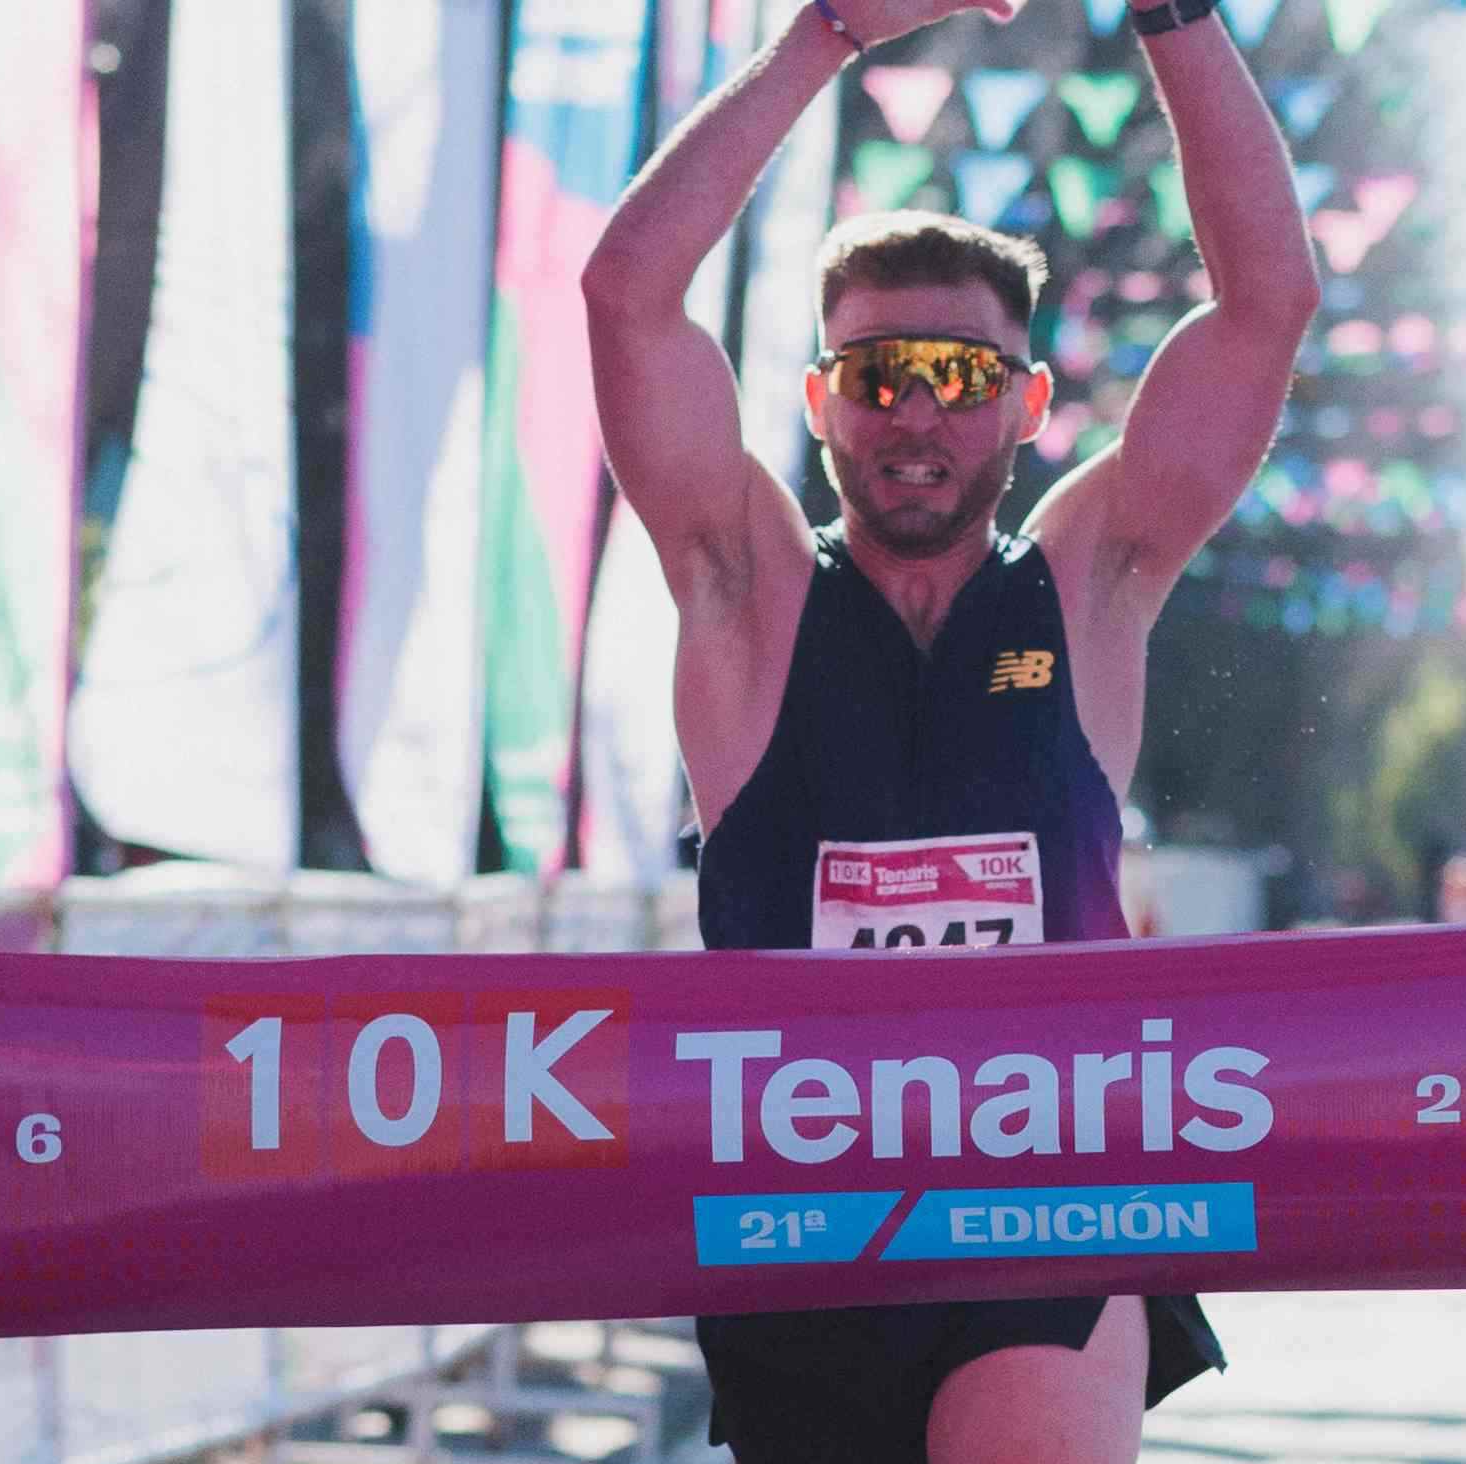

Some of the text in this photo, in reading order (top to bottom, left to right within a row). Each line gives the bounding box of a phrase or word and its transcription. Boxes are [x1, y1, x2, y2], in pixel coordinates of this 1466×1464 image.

[979, 856, 1024, 876] 10K
[675, 1018, 1274, 1164] Tenaris
[949, 1189, 1211, 1244] EDICIÓN
